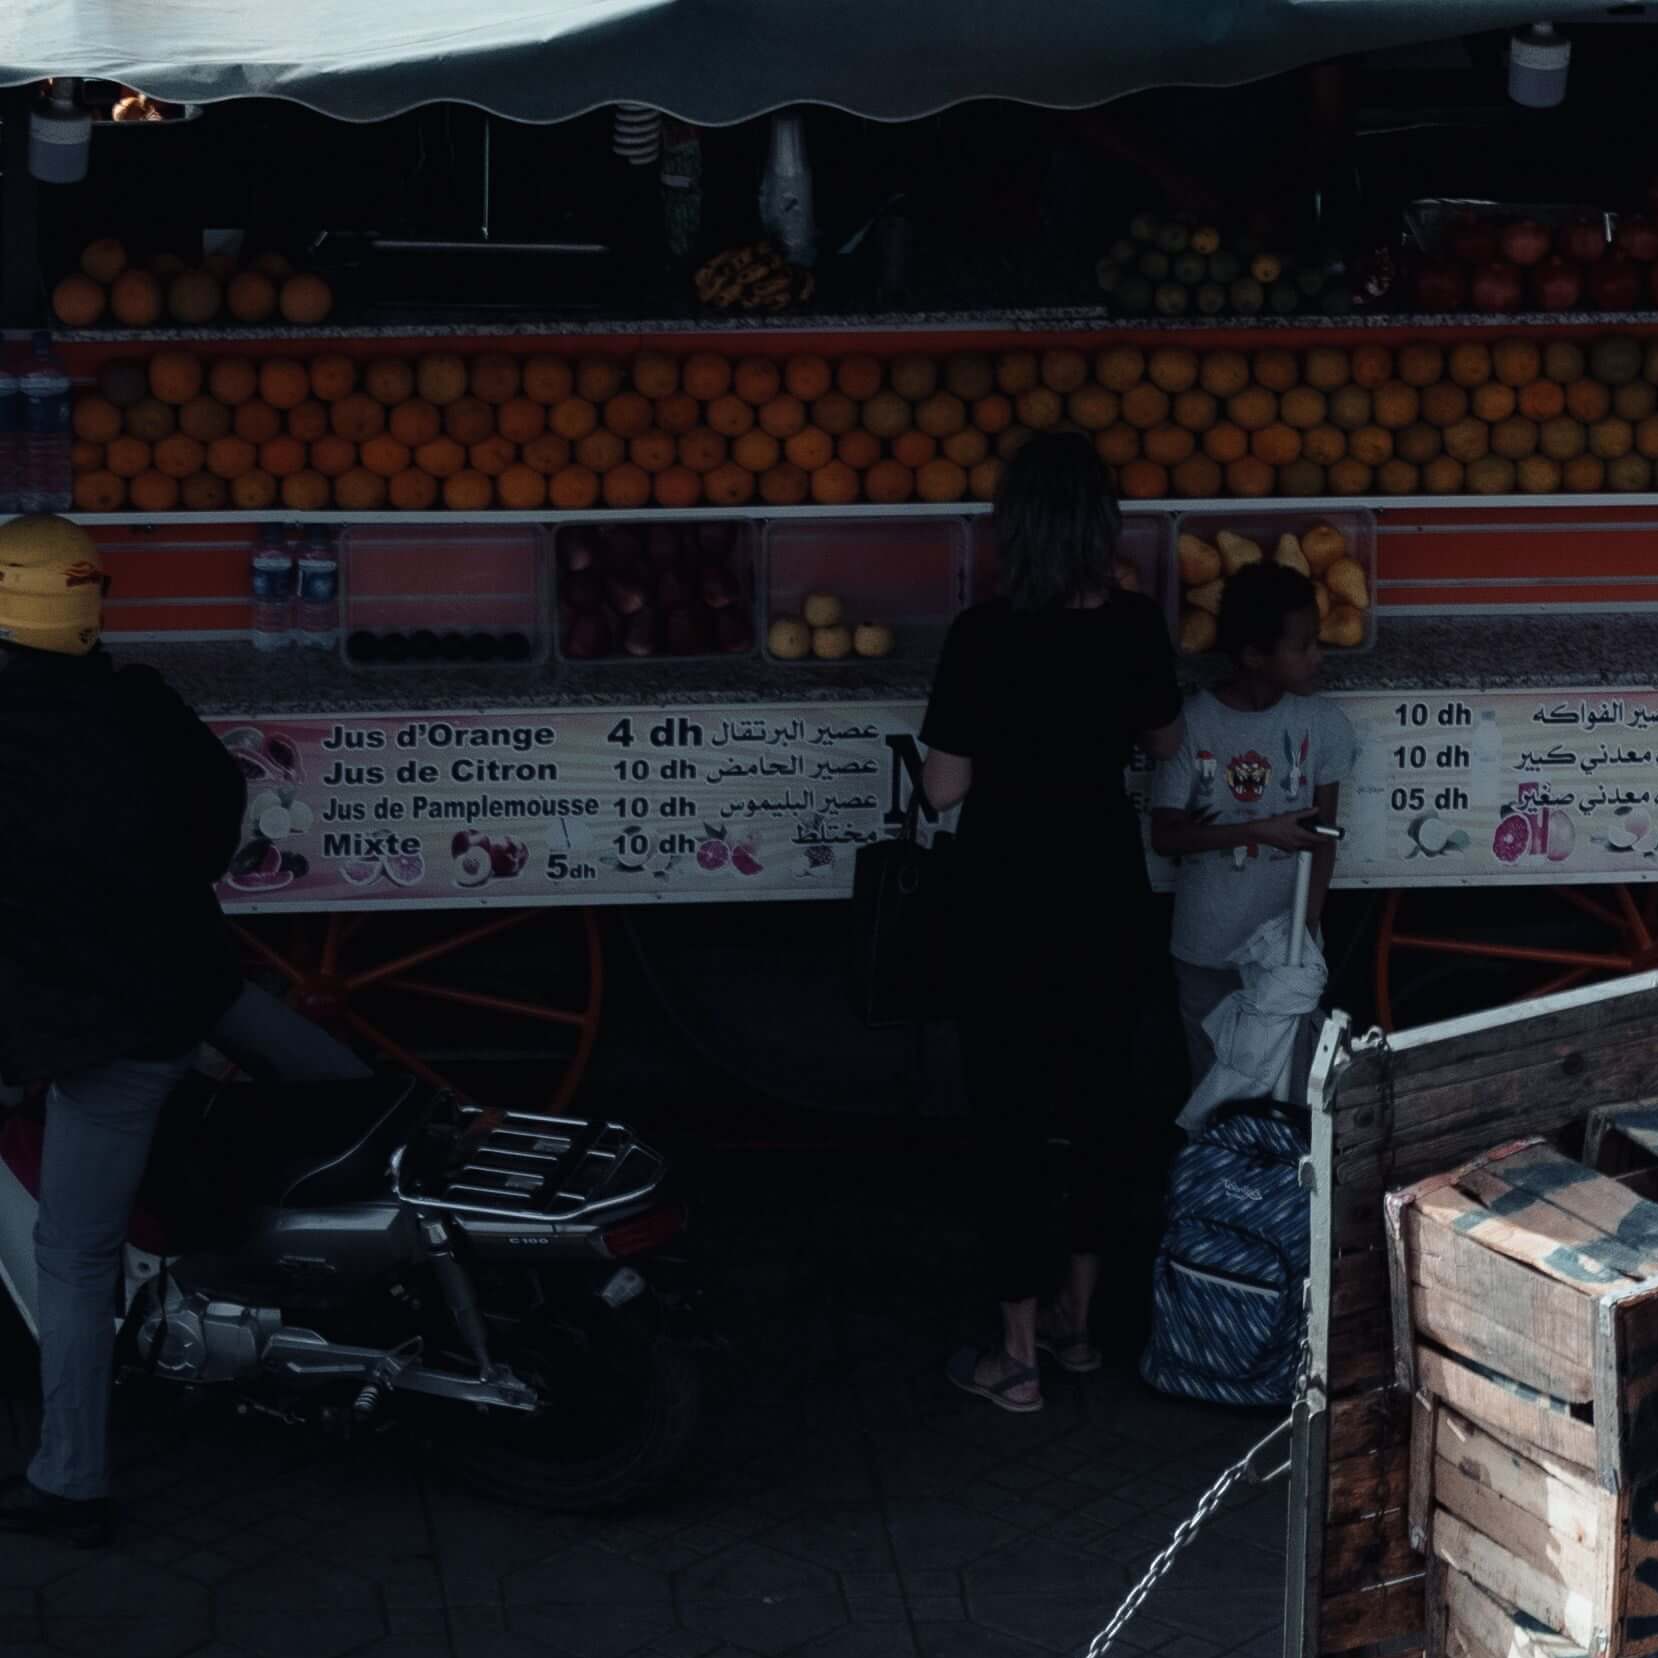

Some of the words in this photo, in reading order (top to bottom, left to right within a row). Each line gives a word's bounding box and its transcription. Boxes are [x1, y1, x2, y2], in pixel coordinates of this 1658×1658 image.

[1394, 704, 1428, 726] 10
[1438, 703, 1472, 726] dh
[323, 725, 386, 749] Jus
[608, 719, 633, 747] 4
[650, 718, 702, 748] dh
[711, 718, 804, 747] البرتقال
[812, 722, 879, 748] عصير
[706, 755, 804, 784] الحامض
[809, 756, 879, 782] عصير
[1393, 747, 1427, 768] 10
[1437, 746, 1469, 768] dh
[1580, 743, 1652, 772] معدني
[323, 761, 386, 785] Jus
[397, 760, 438, 783] de
[452, 759, 557, 782] Citron
[613, 760, 649, 781] 10
[660, 759, 696, 780] dh
[323, 799, 365, 821] Jus
[374, 797, 404, 820] de
[413, 795, 600, 823] Pamplemousse
[613, 798, 649, 818] 10
[660, 797, 696, 817] dh
[822, 793, 878, 819] عصير
[1391, 789, 1424, 811] 05
[1435, 788, 1468, 810] dh
[1578, 784, 1651, 815] معدني
[323, 832, 421, 857] Mixte
[613, 835, 649, 856] 10
[660, 834, 697, 855] dh
